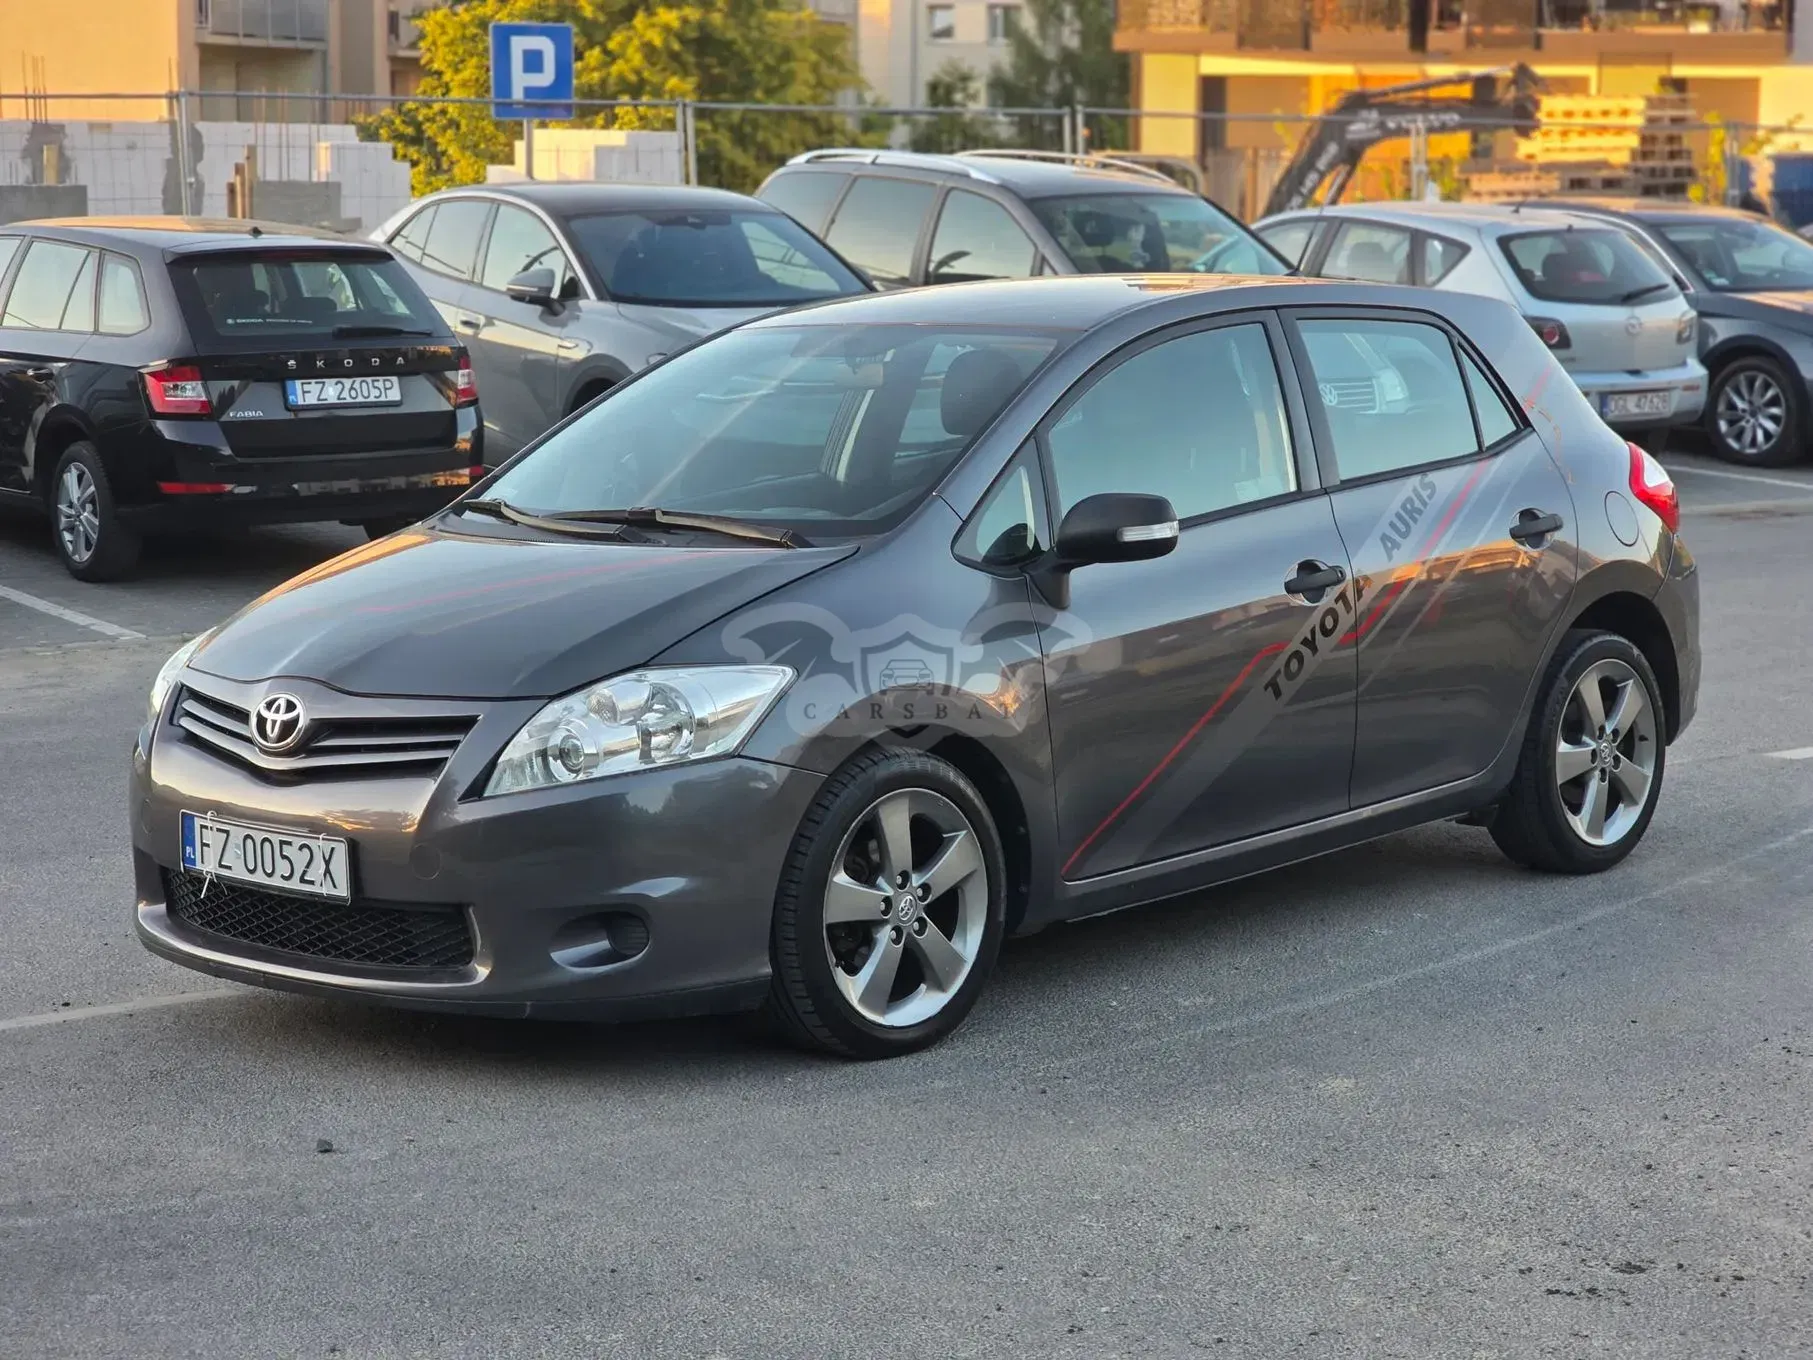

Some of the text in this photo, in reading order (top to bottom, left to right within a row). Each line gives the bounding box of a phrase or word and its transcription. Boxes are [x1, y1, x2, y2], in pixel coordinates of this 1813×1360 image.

[509, 35, 556, 108] P
[229, 410, 264, 418] FABIA
[300, 378, 395, 403] FZ 2605P
[1380, 473, 1437, 563] AURIS
[199, 823, 338, 890] FZ 0052X
